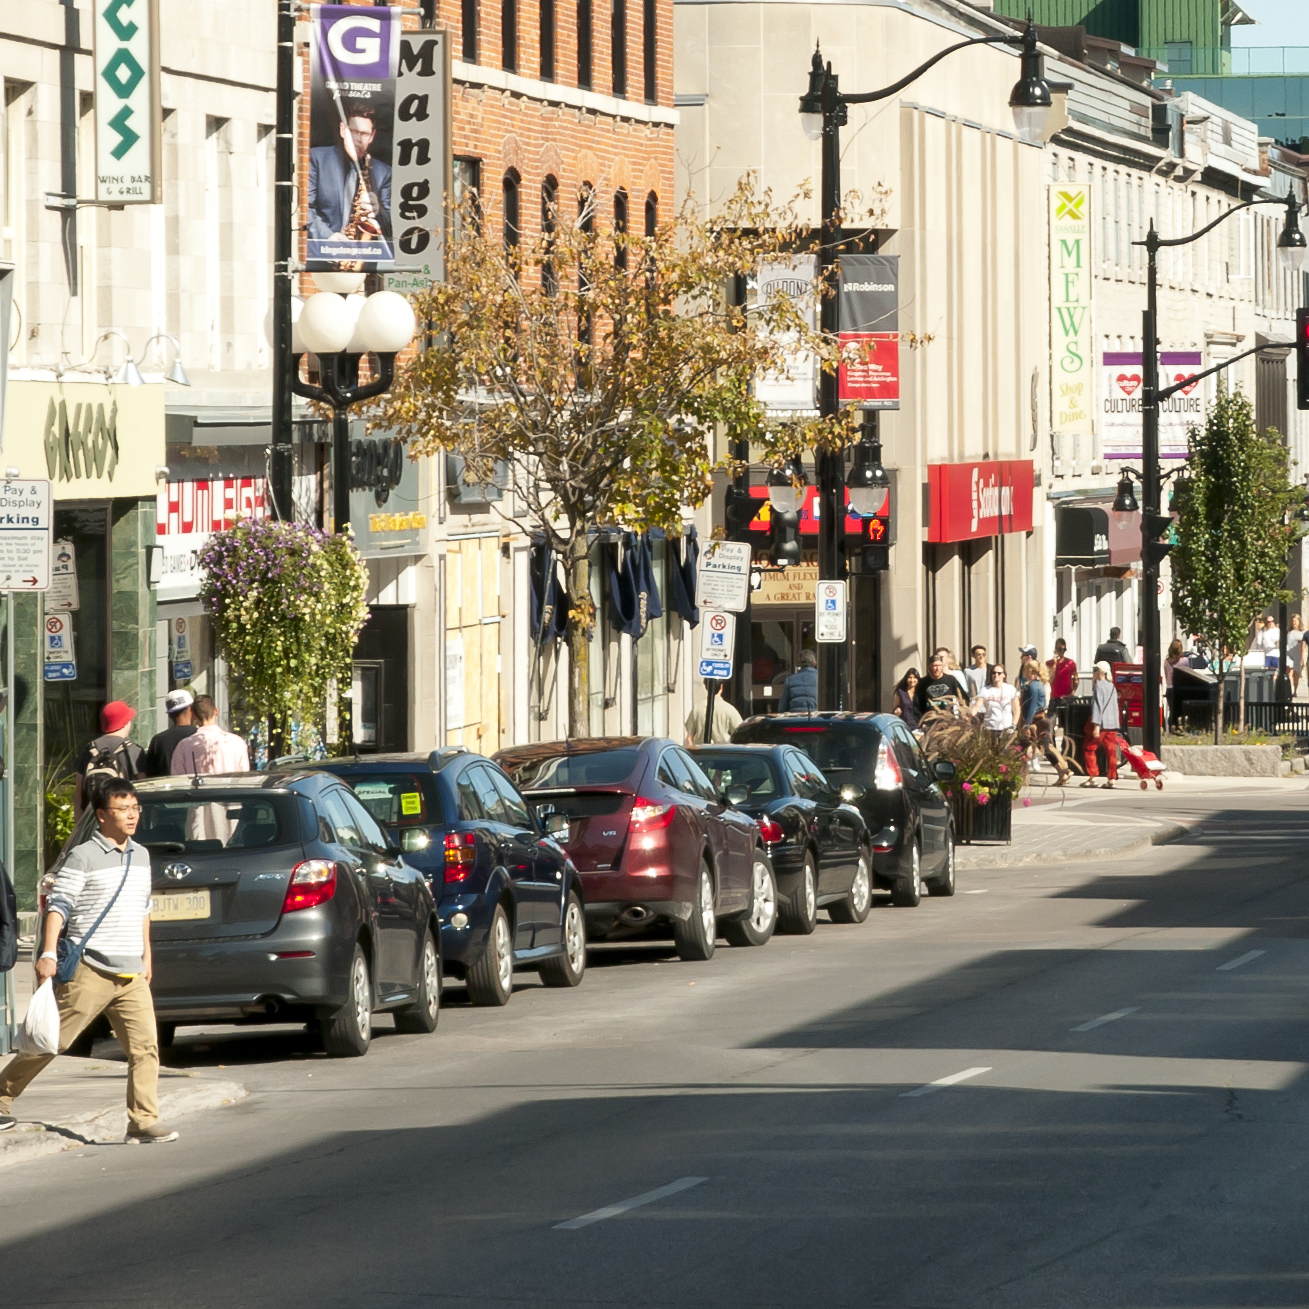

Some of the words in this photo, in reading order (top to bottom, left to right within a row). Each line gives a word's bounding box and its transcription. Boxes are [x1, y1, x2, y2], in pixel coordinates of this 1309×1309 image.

[327, 15, 381, 65] G
[397, 38, 437, 255] Mango
[130, 174, 151, 184] BAR
[118, 186, 143, 195] GRILL
[853, 282, 895, 292] Robinson
[1054, 238, 1088, 374] MEWS
[1059, 381, 1083, 399] Shop
[1068, 396, 1079, 409] &
[1104, 398, 1143, 413] CULTURE
[1161, 398, 1201, 413] CULTURE
[1059, 408, 1087, 426] Dine
[3, 484, 25, 497] Pay
[30, 485, 38, 496] &
[0, 497, 43, 510] Display
[705, 561, 742, 572] Parking
[787, 583, 804, 591] AND
[774, 592, 802, 601] GREAT
[805, 591, 818, 601] RA
[185, 896, 205, 911] 300
